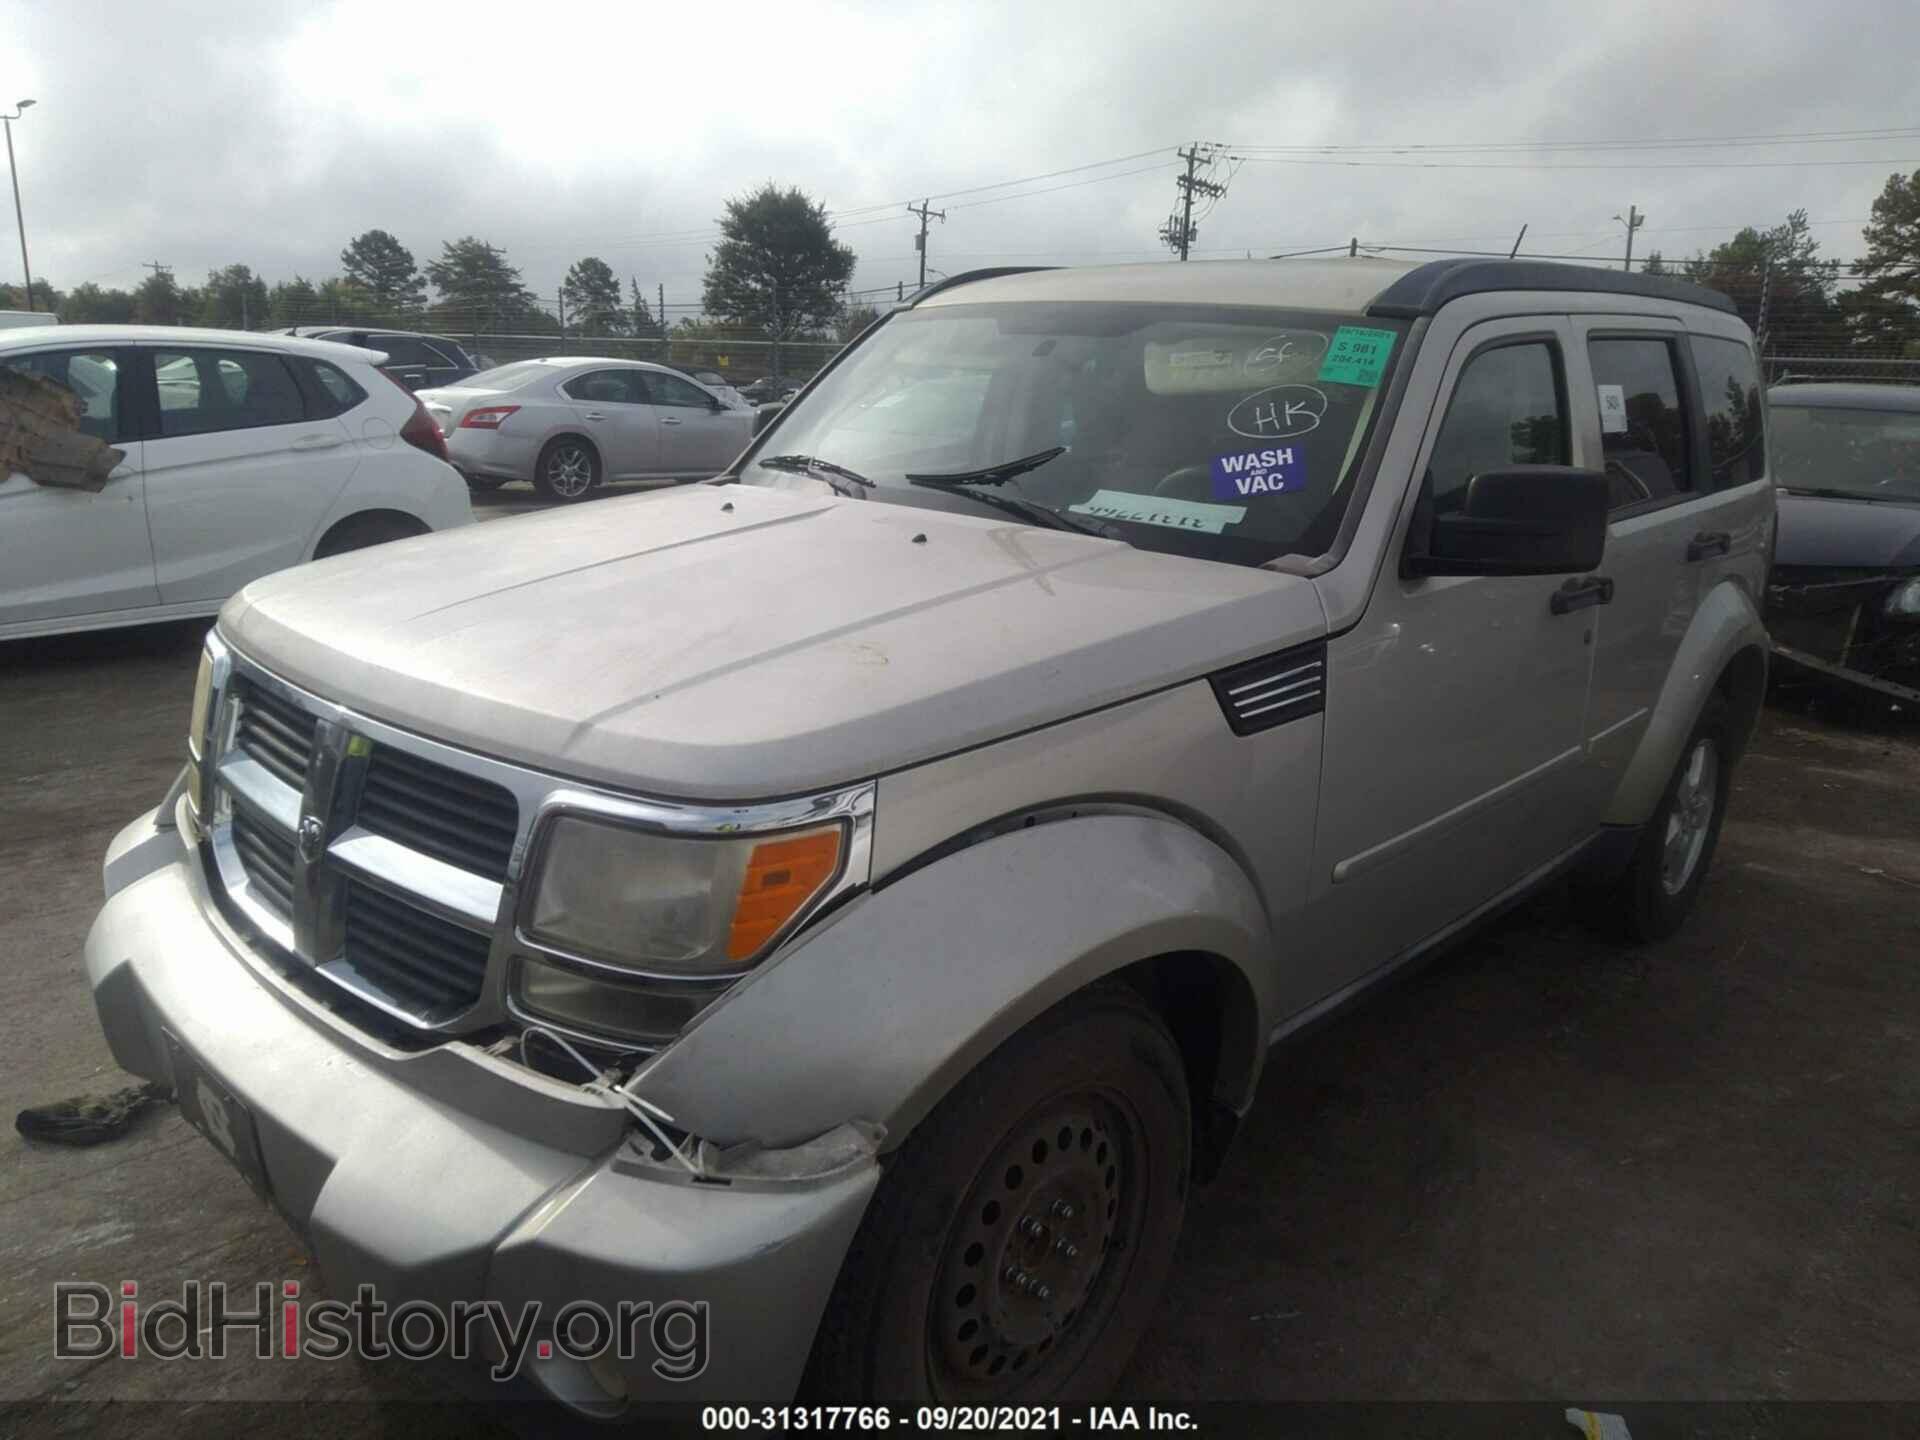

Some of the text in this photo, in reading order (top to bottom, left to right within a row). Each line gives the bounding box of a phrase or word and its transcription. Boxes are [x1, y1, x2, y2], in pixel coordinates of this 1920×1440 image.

[1254, 400, 1320, 433] HK
[1221, 447, 1294, 473] WASH
[1234, 473, 1284, 495] VAC
